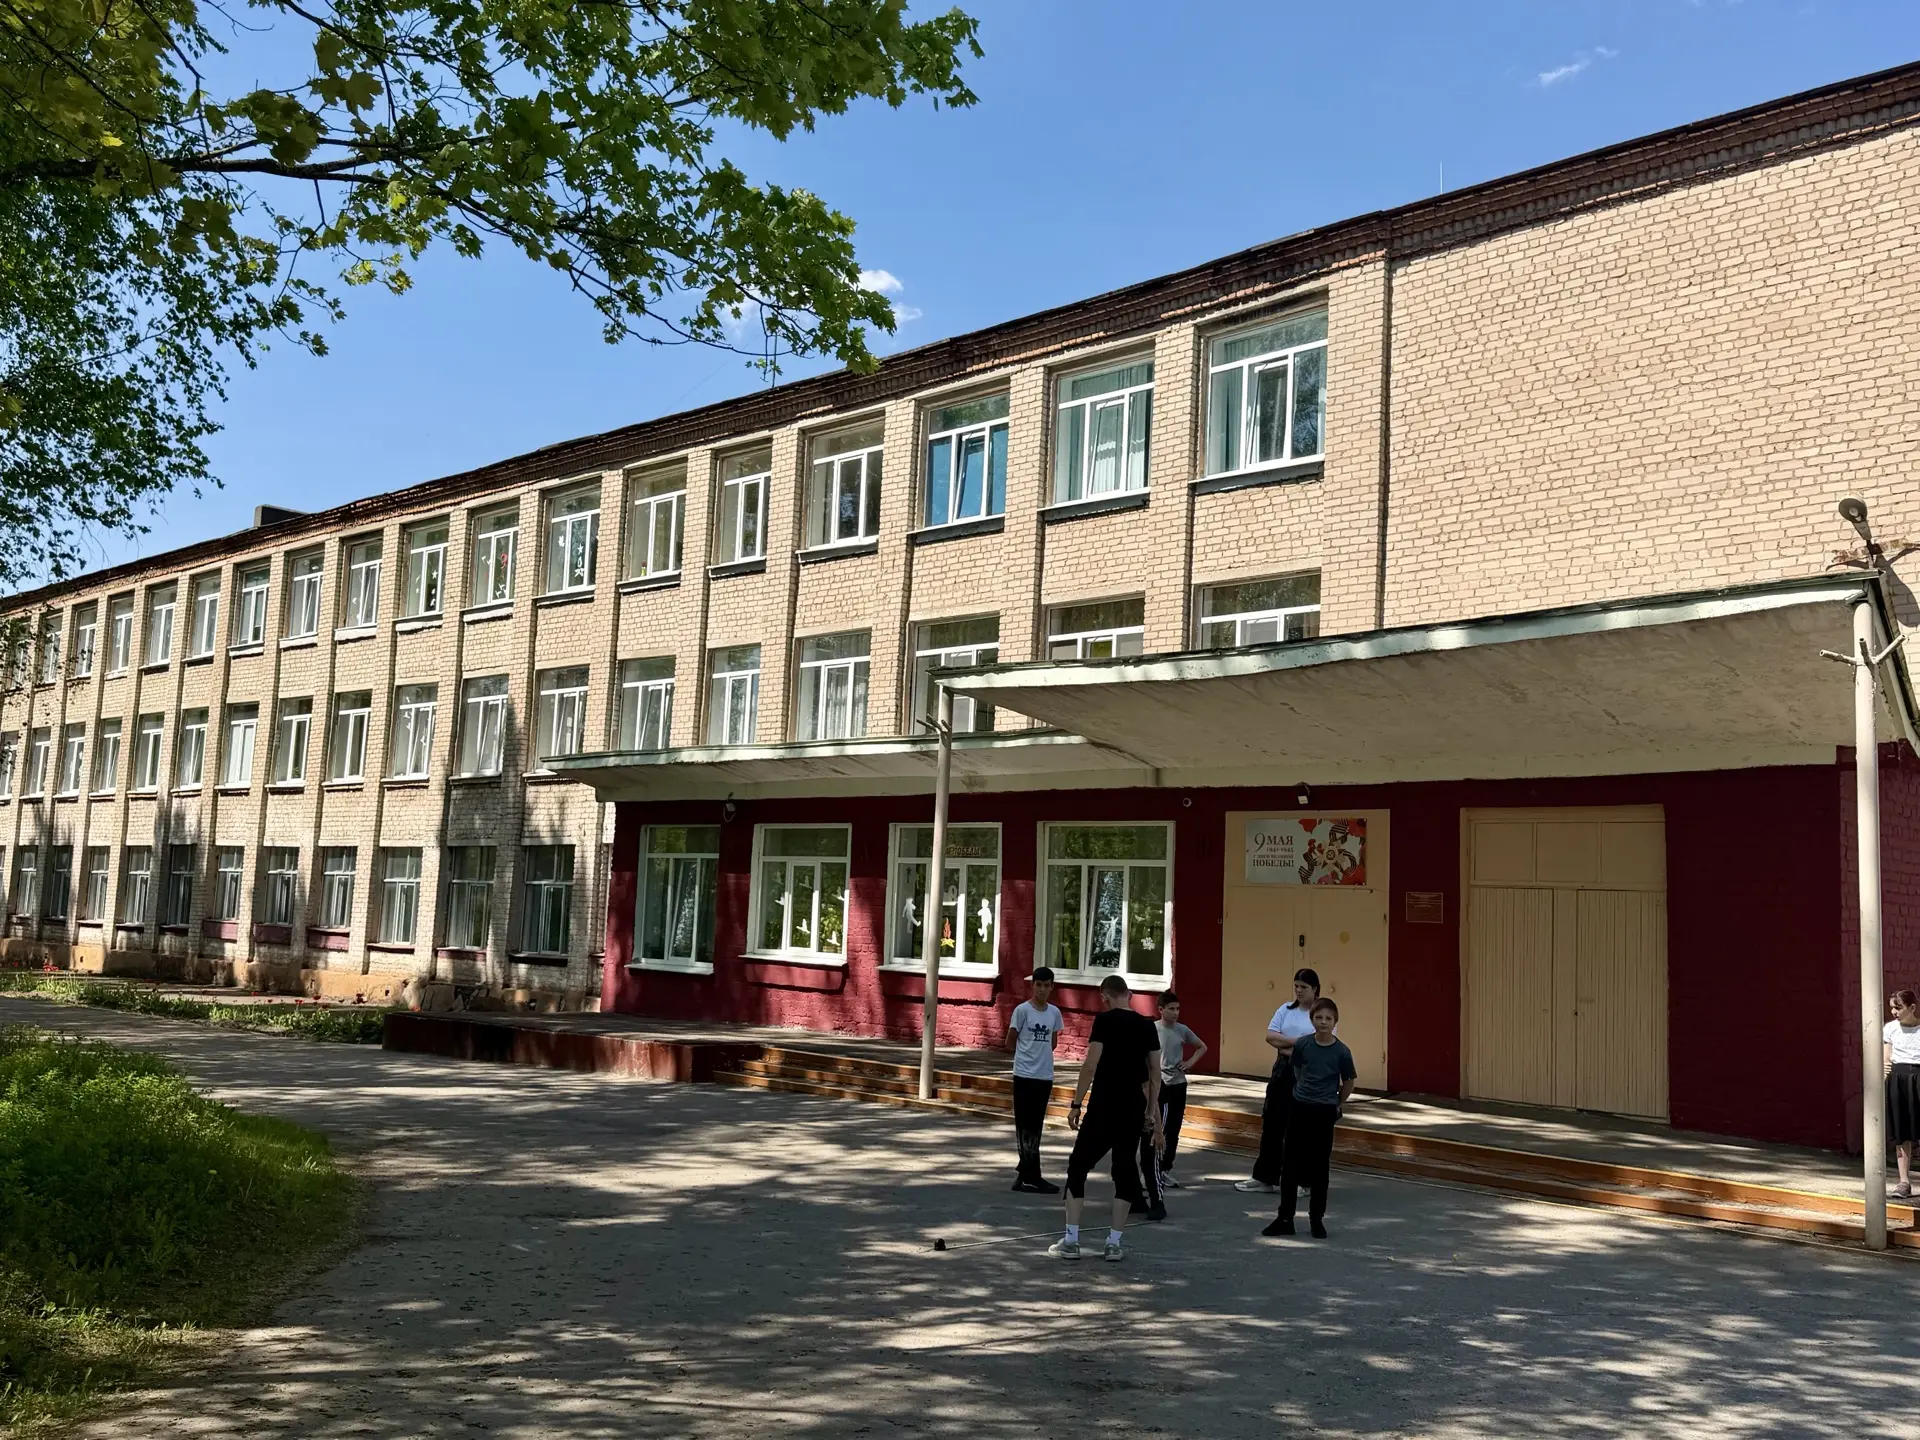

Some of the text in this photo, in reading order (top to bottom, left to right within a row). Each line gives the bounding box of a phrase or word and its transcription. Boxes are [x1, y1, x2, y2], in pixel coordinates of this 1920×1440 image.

[1254, 832, 1294, 852] 9 МАЯ
[1252, 859, 1294, 868] ПОБЕДЫ!
